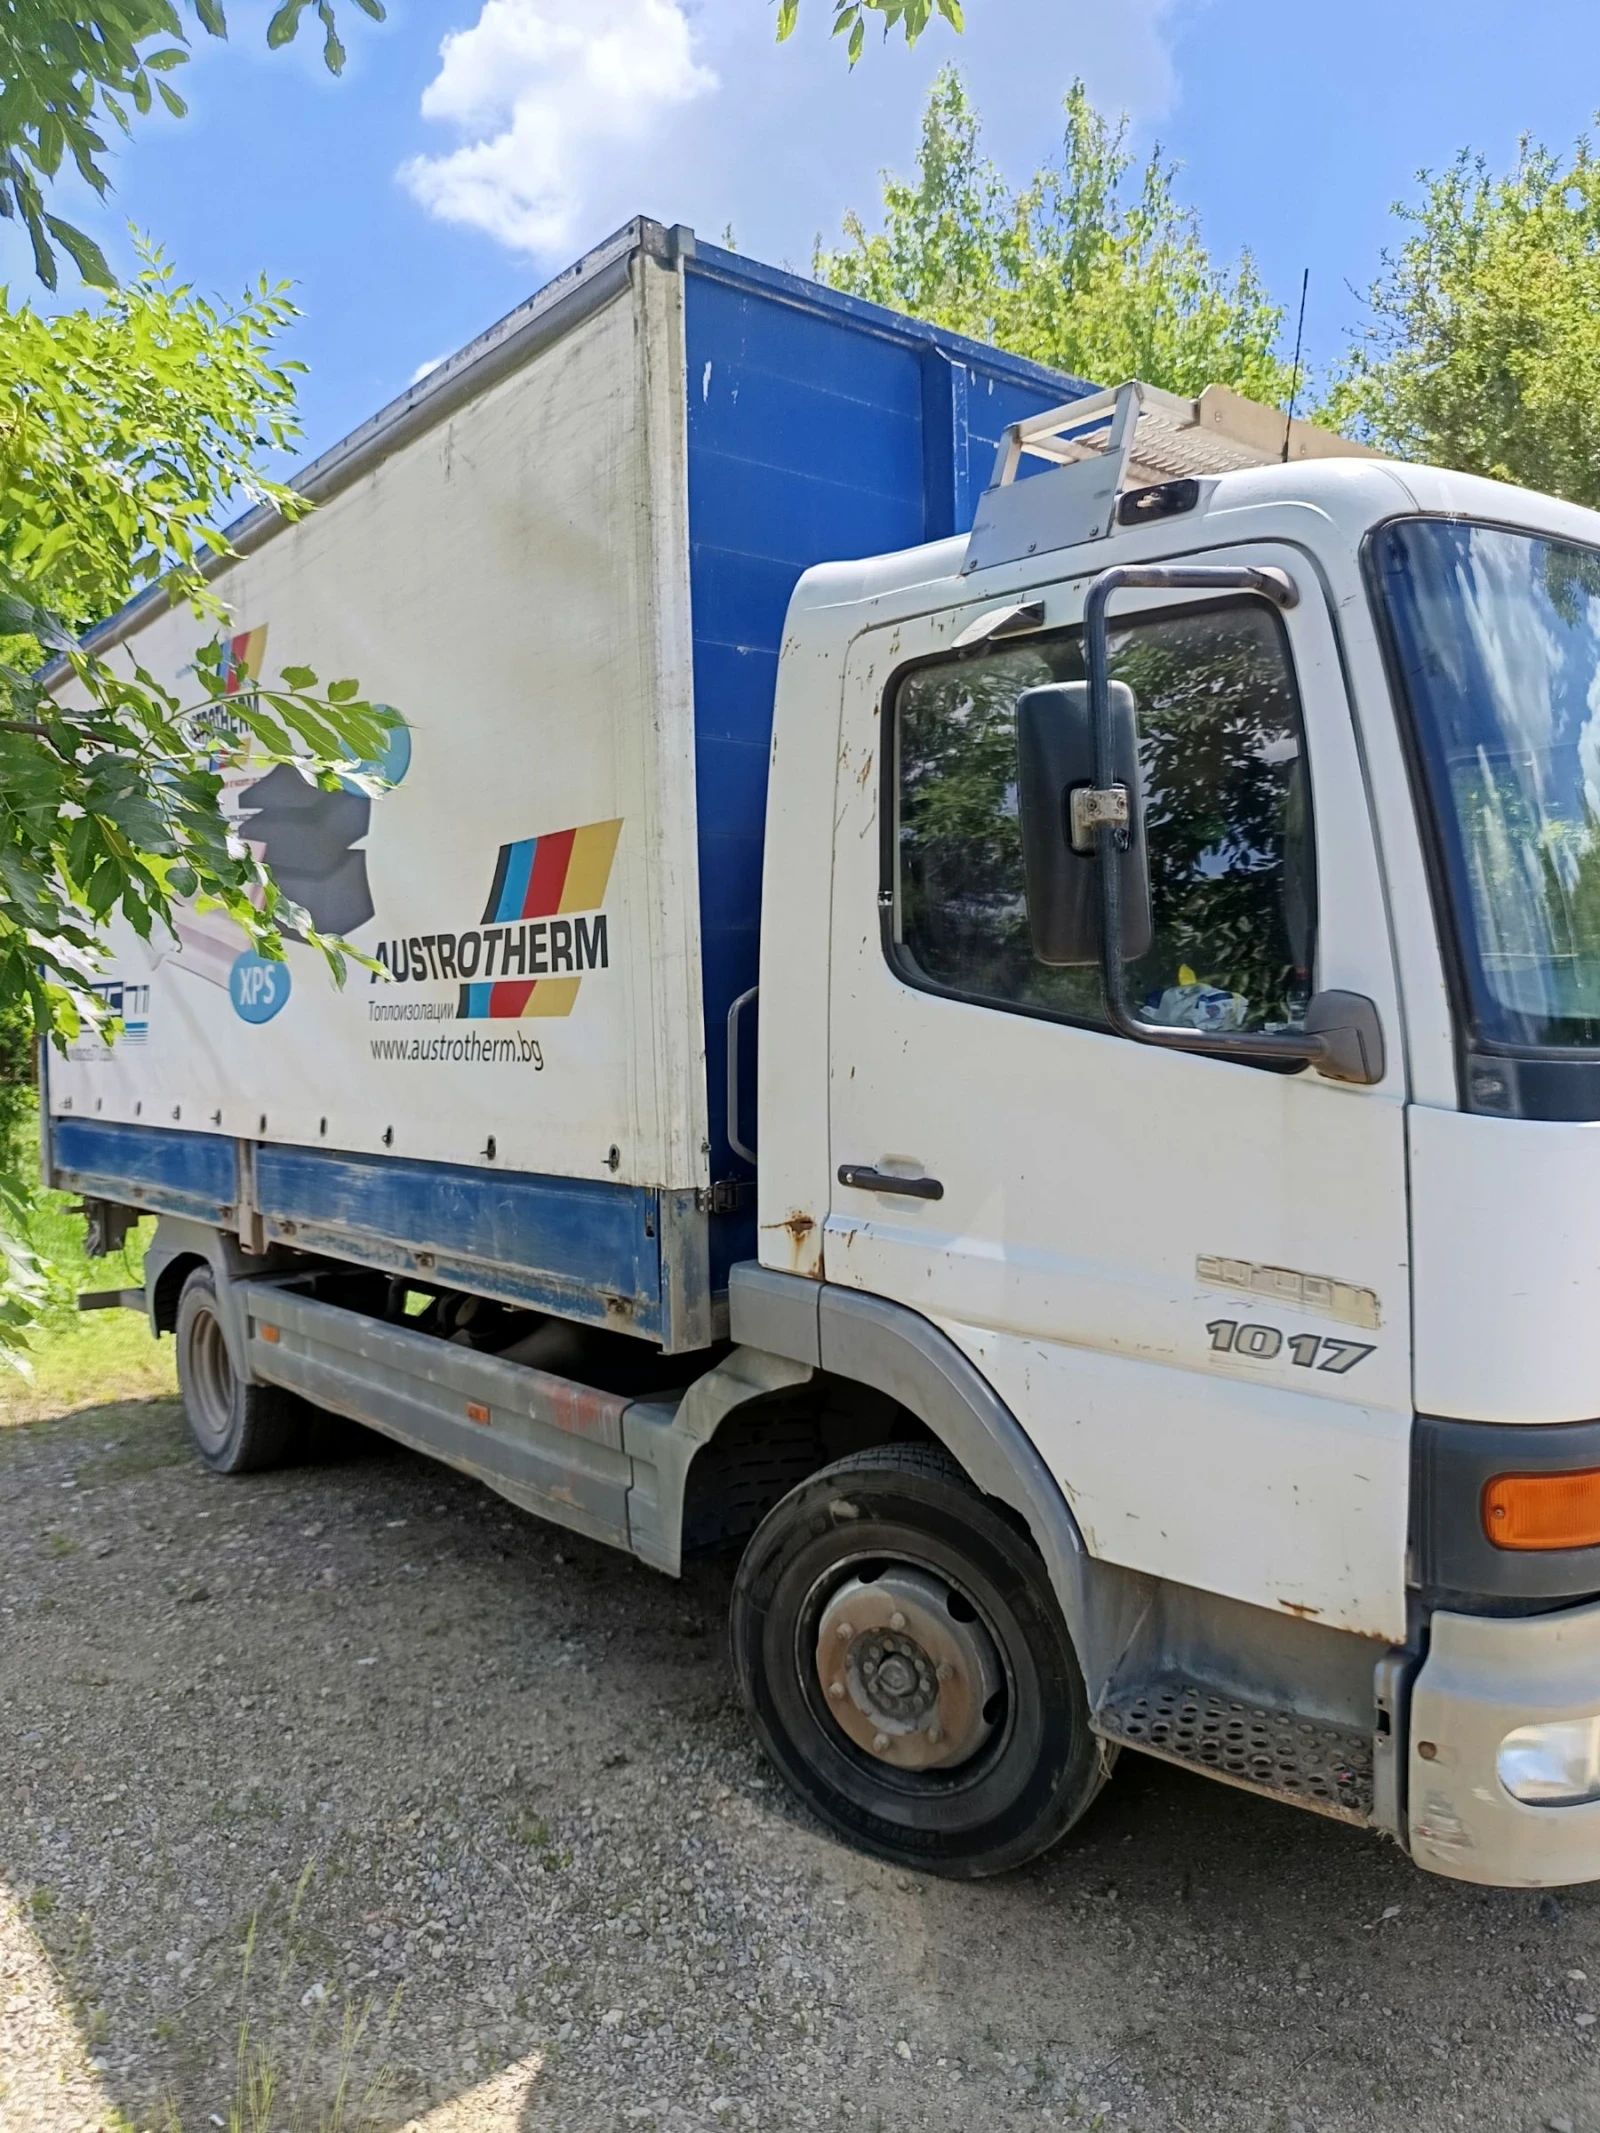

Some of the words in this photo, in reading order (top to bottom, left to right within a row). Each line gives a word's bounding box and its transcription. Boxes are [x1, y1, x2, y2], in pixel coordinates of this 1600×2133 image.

[370, 914, 609, 984] AUSTROTHERM
[239, 965, 276, 1006] XPS
[368, 1001, 454, 1023] Топлоизолации
[370, 1030, 544, 1071] www.austrotherm.bg
[1205, 1318, 1378, 1374] 1017
